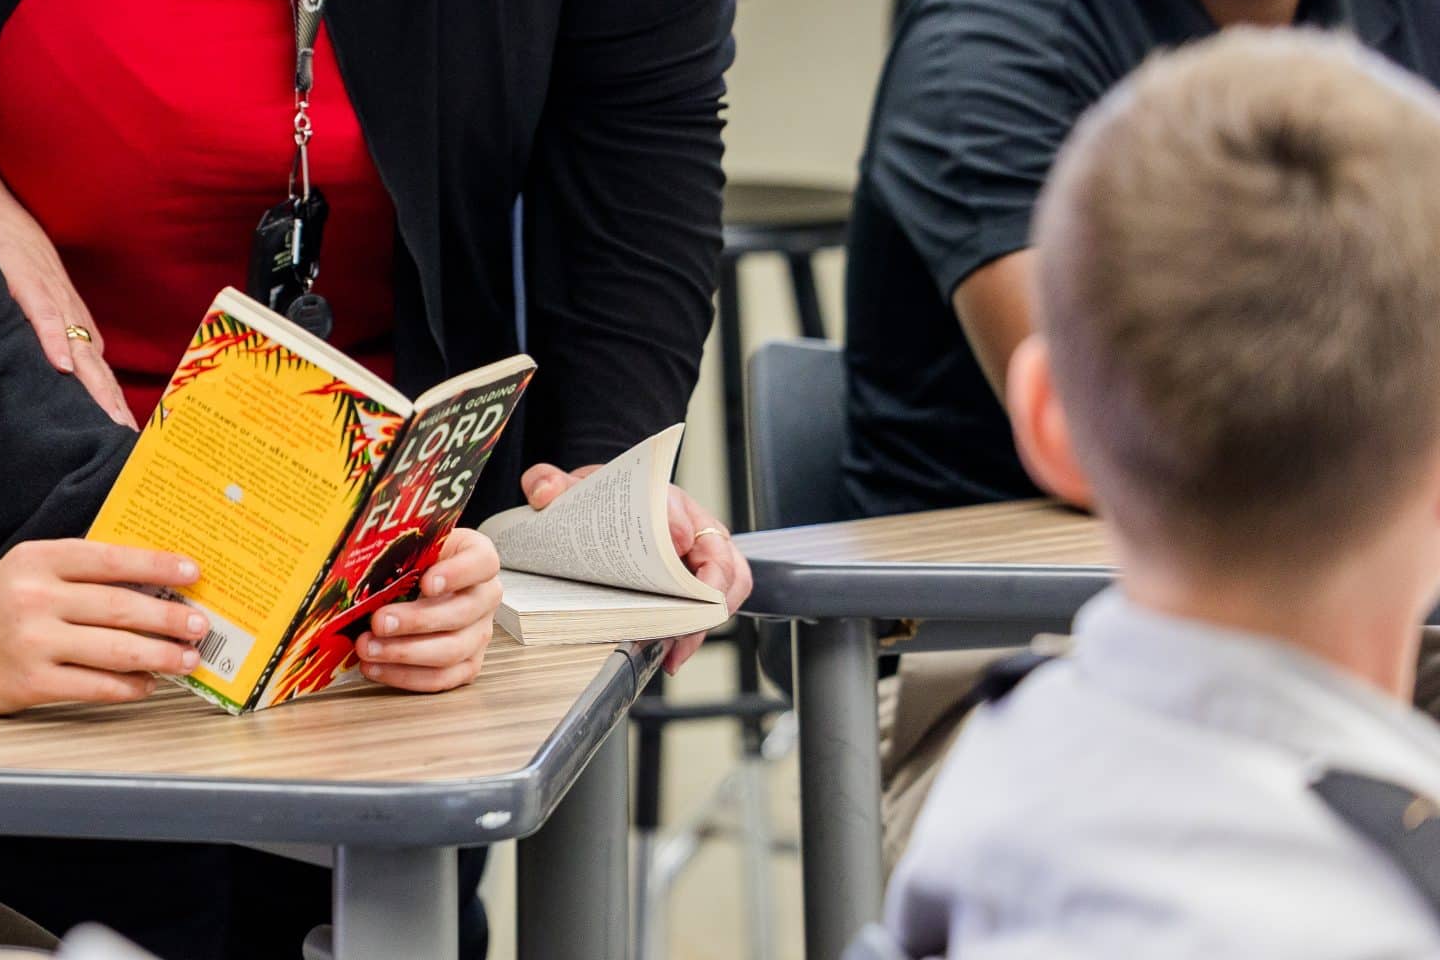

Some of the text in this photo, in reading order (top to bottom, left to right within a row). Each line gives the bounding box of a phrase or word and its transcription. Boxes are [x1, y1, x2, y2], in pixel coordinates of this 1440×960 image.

[465, 383, 517, 410] GOLDING
[393, 403, 504, 474] LORD
[429, 453, 461, 476] the
[355, 470, 473, 543] FLIES
